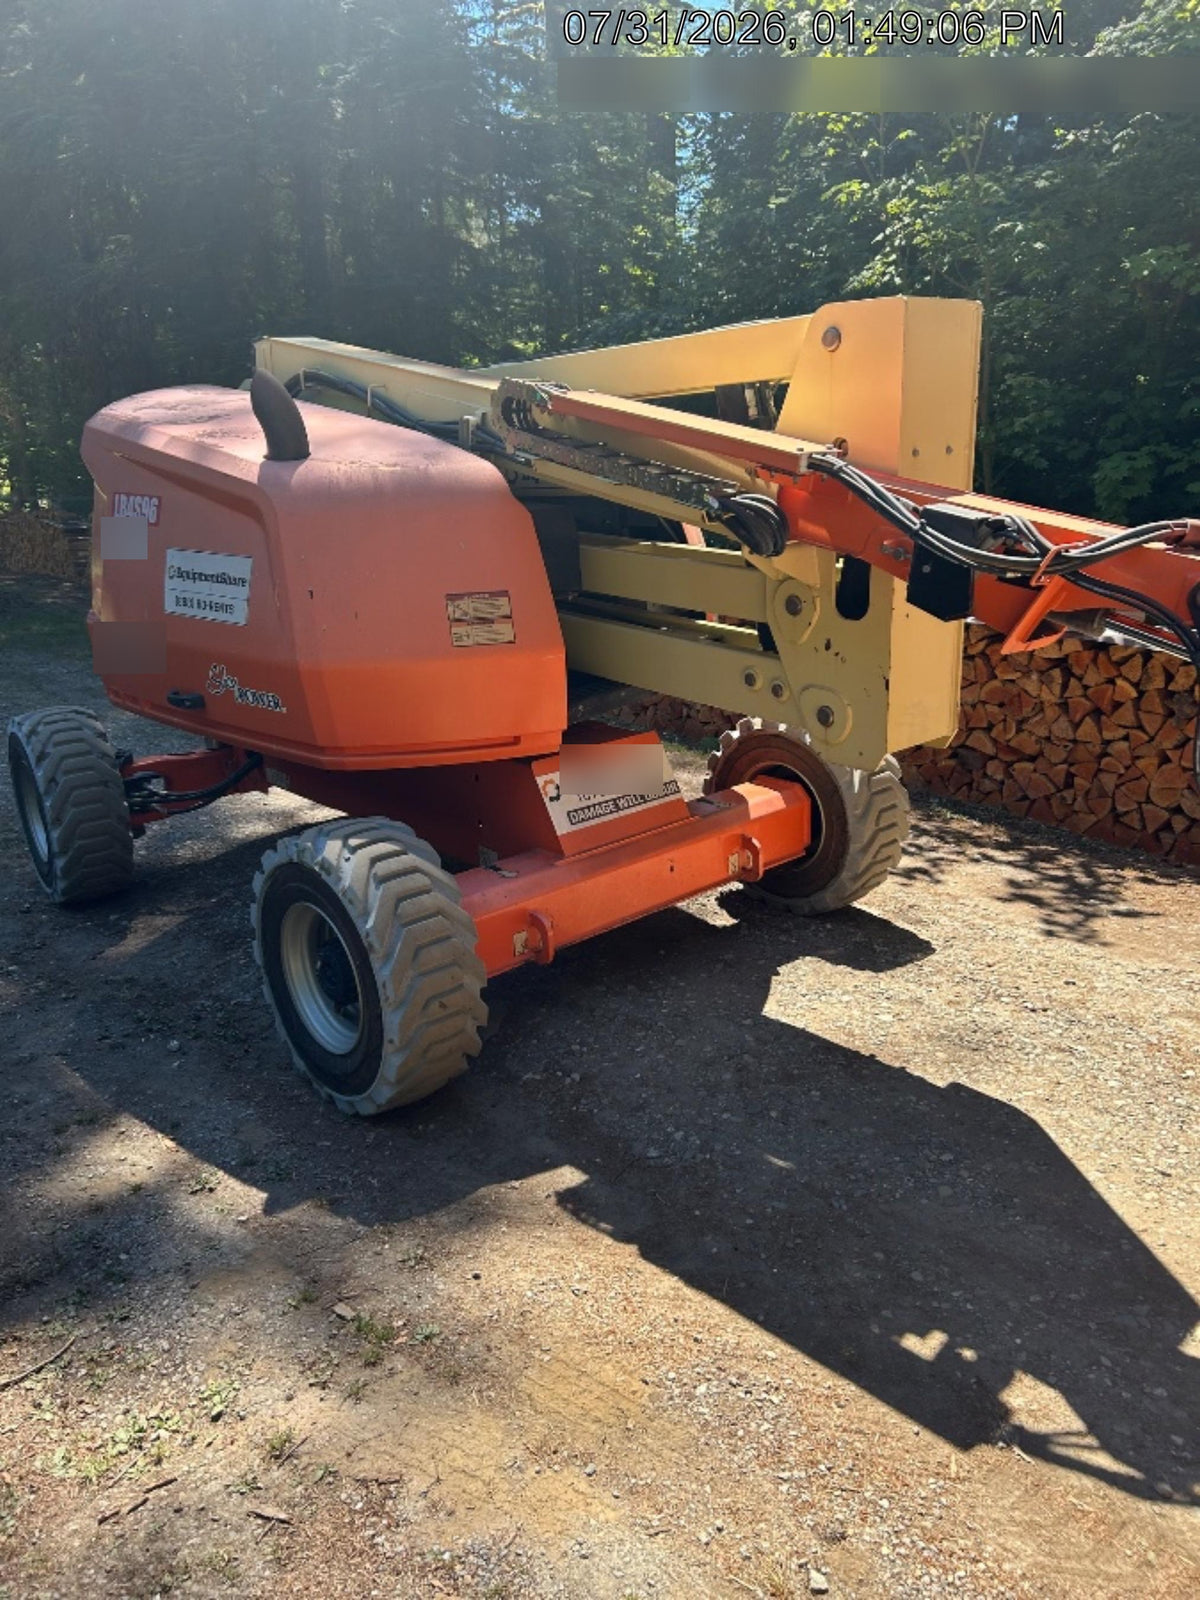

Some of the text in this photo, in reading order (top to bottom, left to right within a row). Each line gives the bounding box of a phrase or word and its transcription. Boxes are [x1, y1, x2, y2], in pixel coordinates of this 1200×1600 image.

[176, 566, 247, 588] EquipmentShare
[569, 800, 617, 824] DAMAGE
[616, 794, 645, 810] WILL
